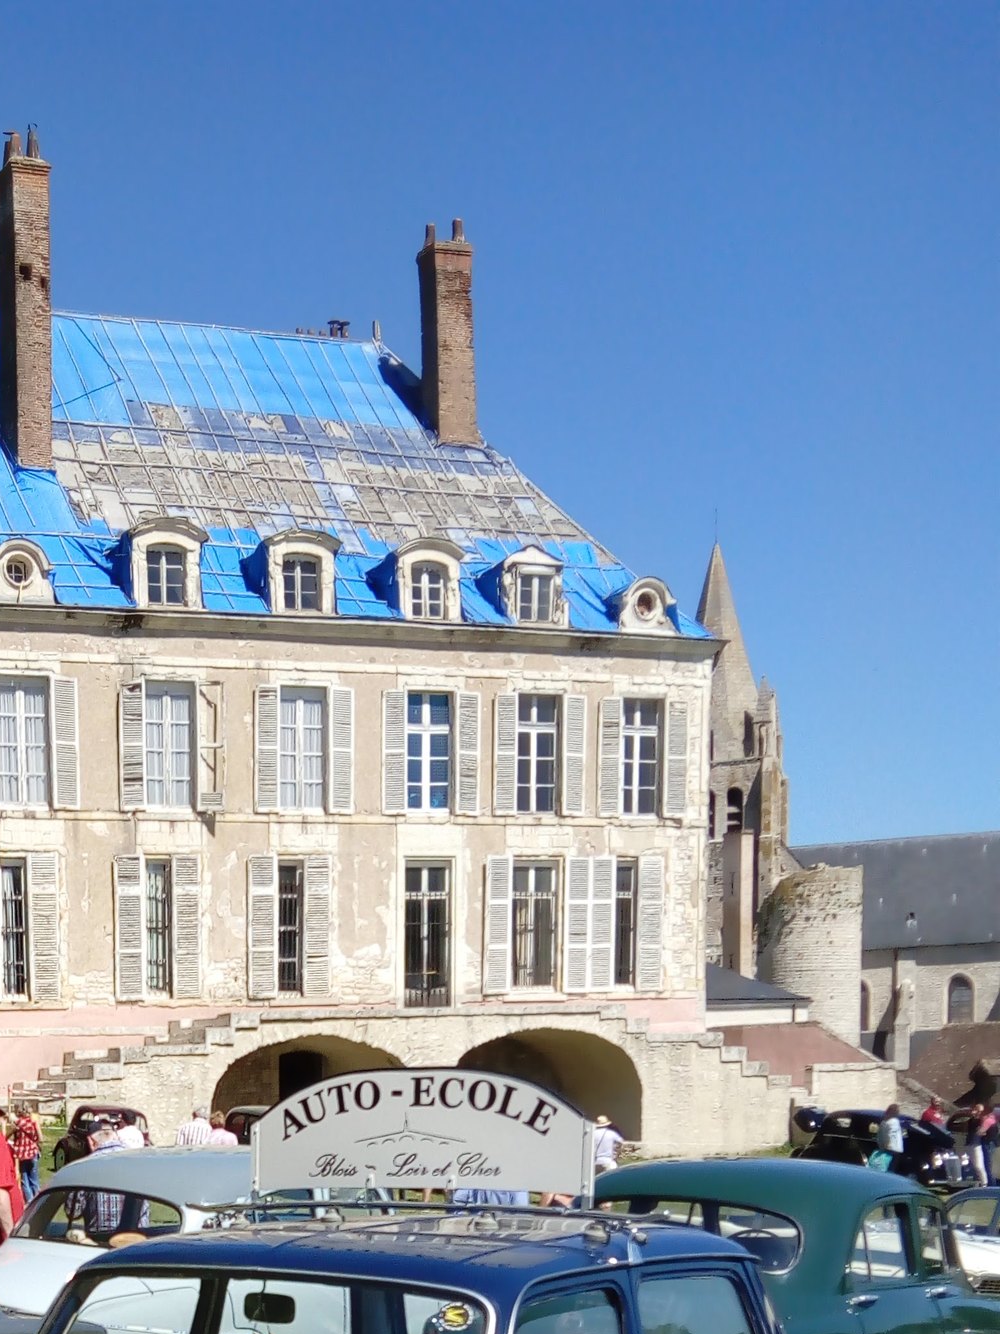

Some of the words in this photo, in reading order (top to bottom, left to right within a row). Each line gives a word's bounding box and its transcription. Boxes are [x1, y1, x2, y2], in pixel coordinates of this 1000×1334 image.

[308, 1153, 359, 1178] Blois
[386, 1152, 430, 1178] Loir
[431, 1161, 453, 1177] et
[456, 1152, 502, 1178] Cher
